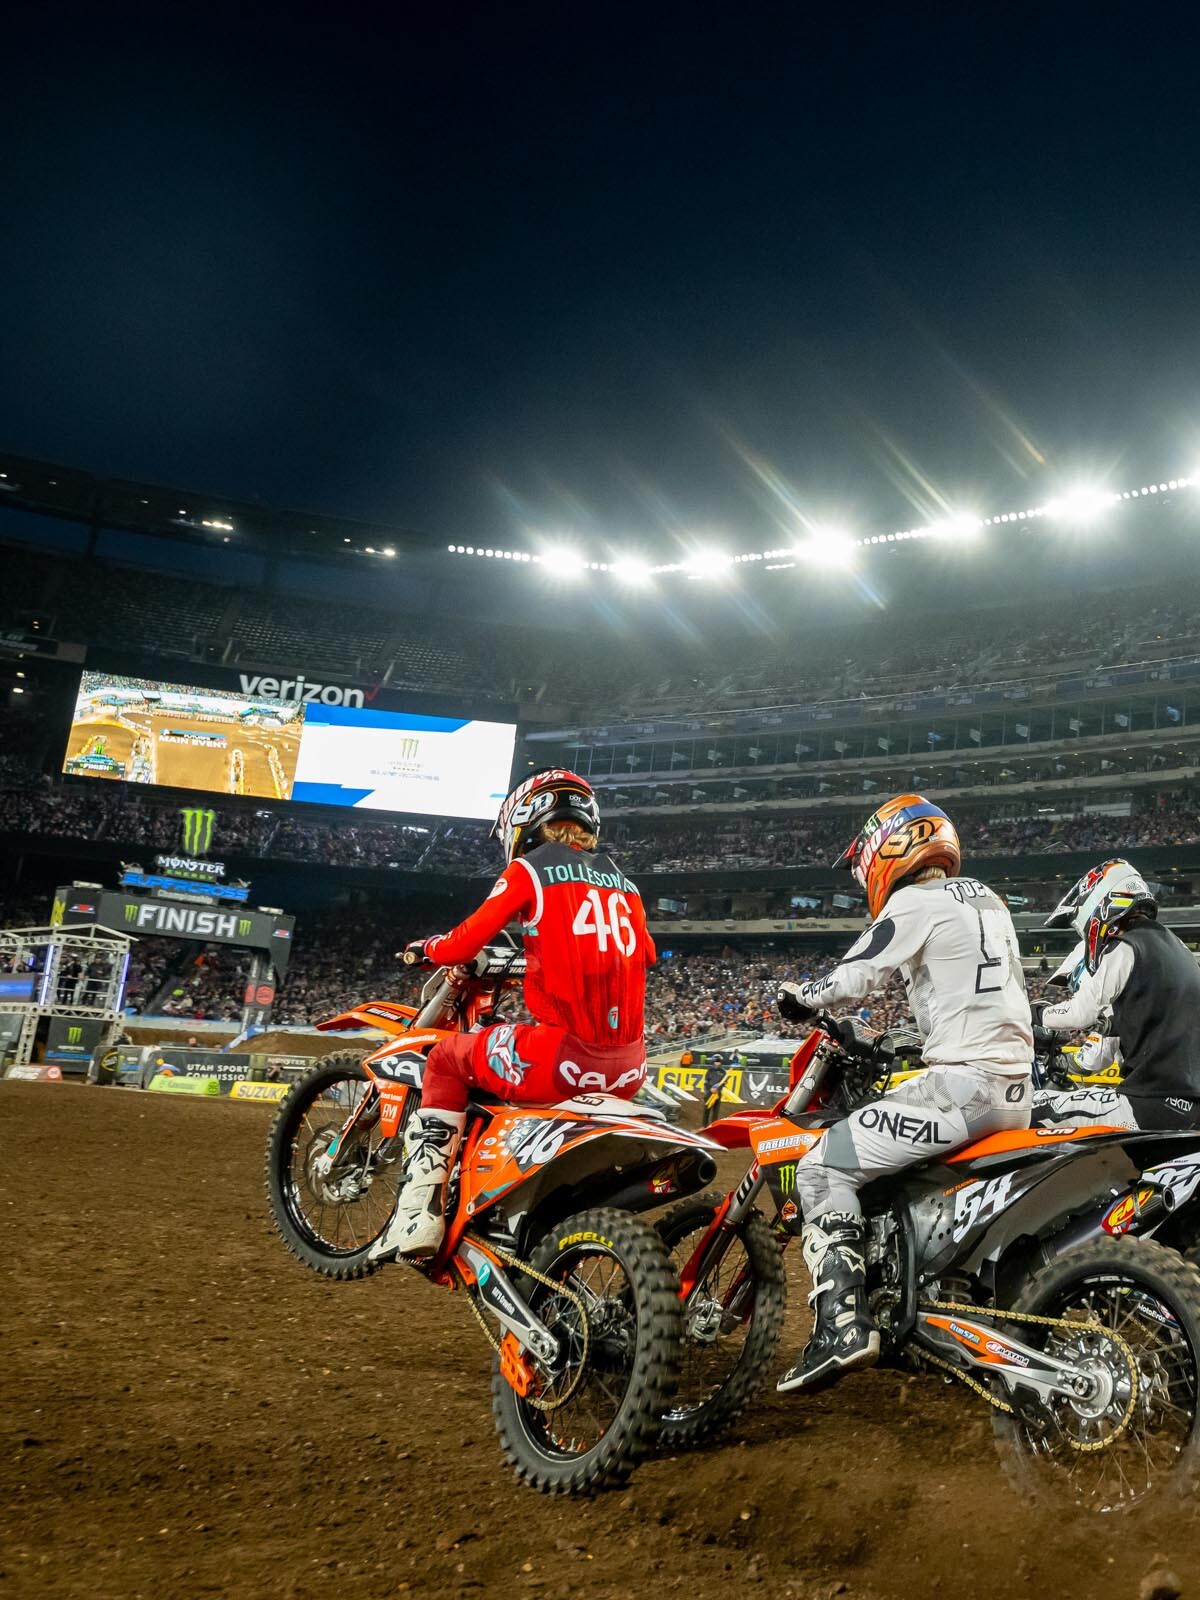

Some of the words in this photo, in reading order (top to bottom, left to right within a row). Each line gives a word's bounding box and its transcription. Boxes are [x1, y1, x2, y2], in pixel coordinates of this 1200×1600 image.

[239, 674, 365, 708] verizon
[159, 735, 189, 746] MAIN
[191, 738, 228, 749] EVENT
[157, 855, 225, 876] MONSTER
[166, 869, 214, 881] ENERGY
[543, 863, 622, 889] TOLLESON
[121, 872, 250, 901] SUPERCROSS
[136, 904, 238, 939] FINISH
[572, 888, 637, 958] 46
[186, 1072, 247, 1082] COMMISSIO
[187, 1063, 214, 1072] UTAH
[217, 1065, 249, 1074] SPORT
[663, 1071, 738, 1092] SUZI
[858, 1108, 952, 1145] O'NEAL
[757, 1134, 812, 1153] BABBITT'S
[952, 1170, 1017, 1244] 54
[1111, 1225, 1123, 1234] 41
[558, 1230, 614, 1251] PIRELLI
